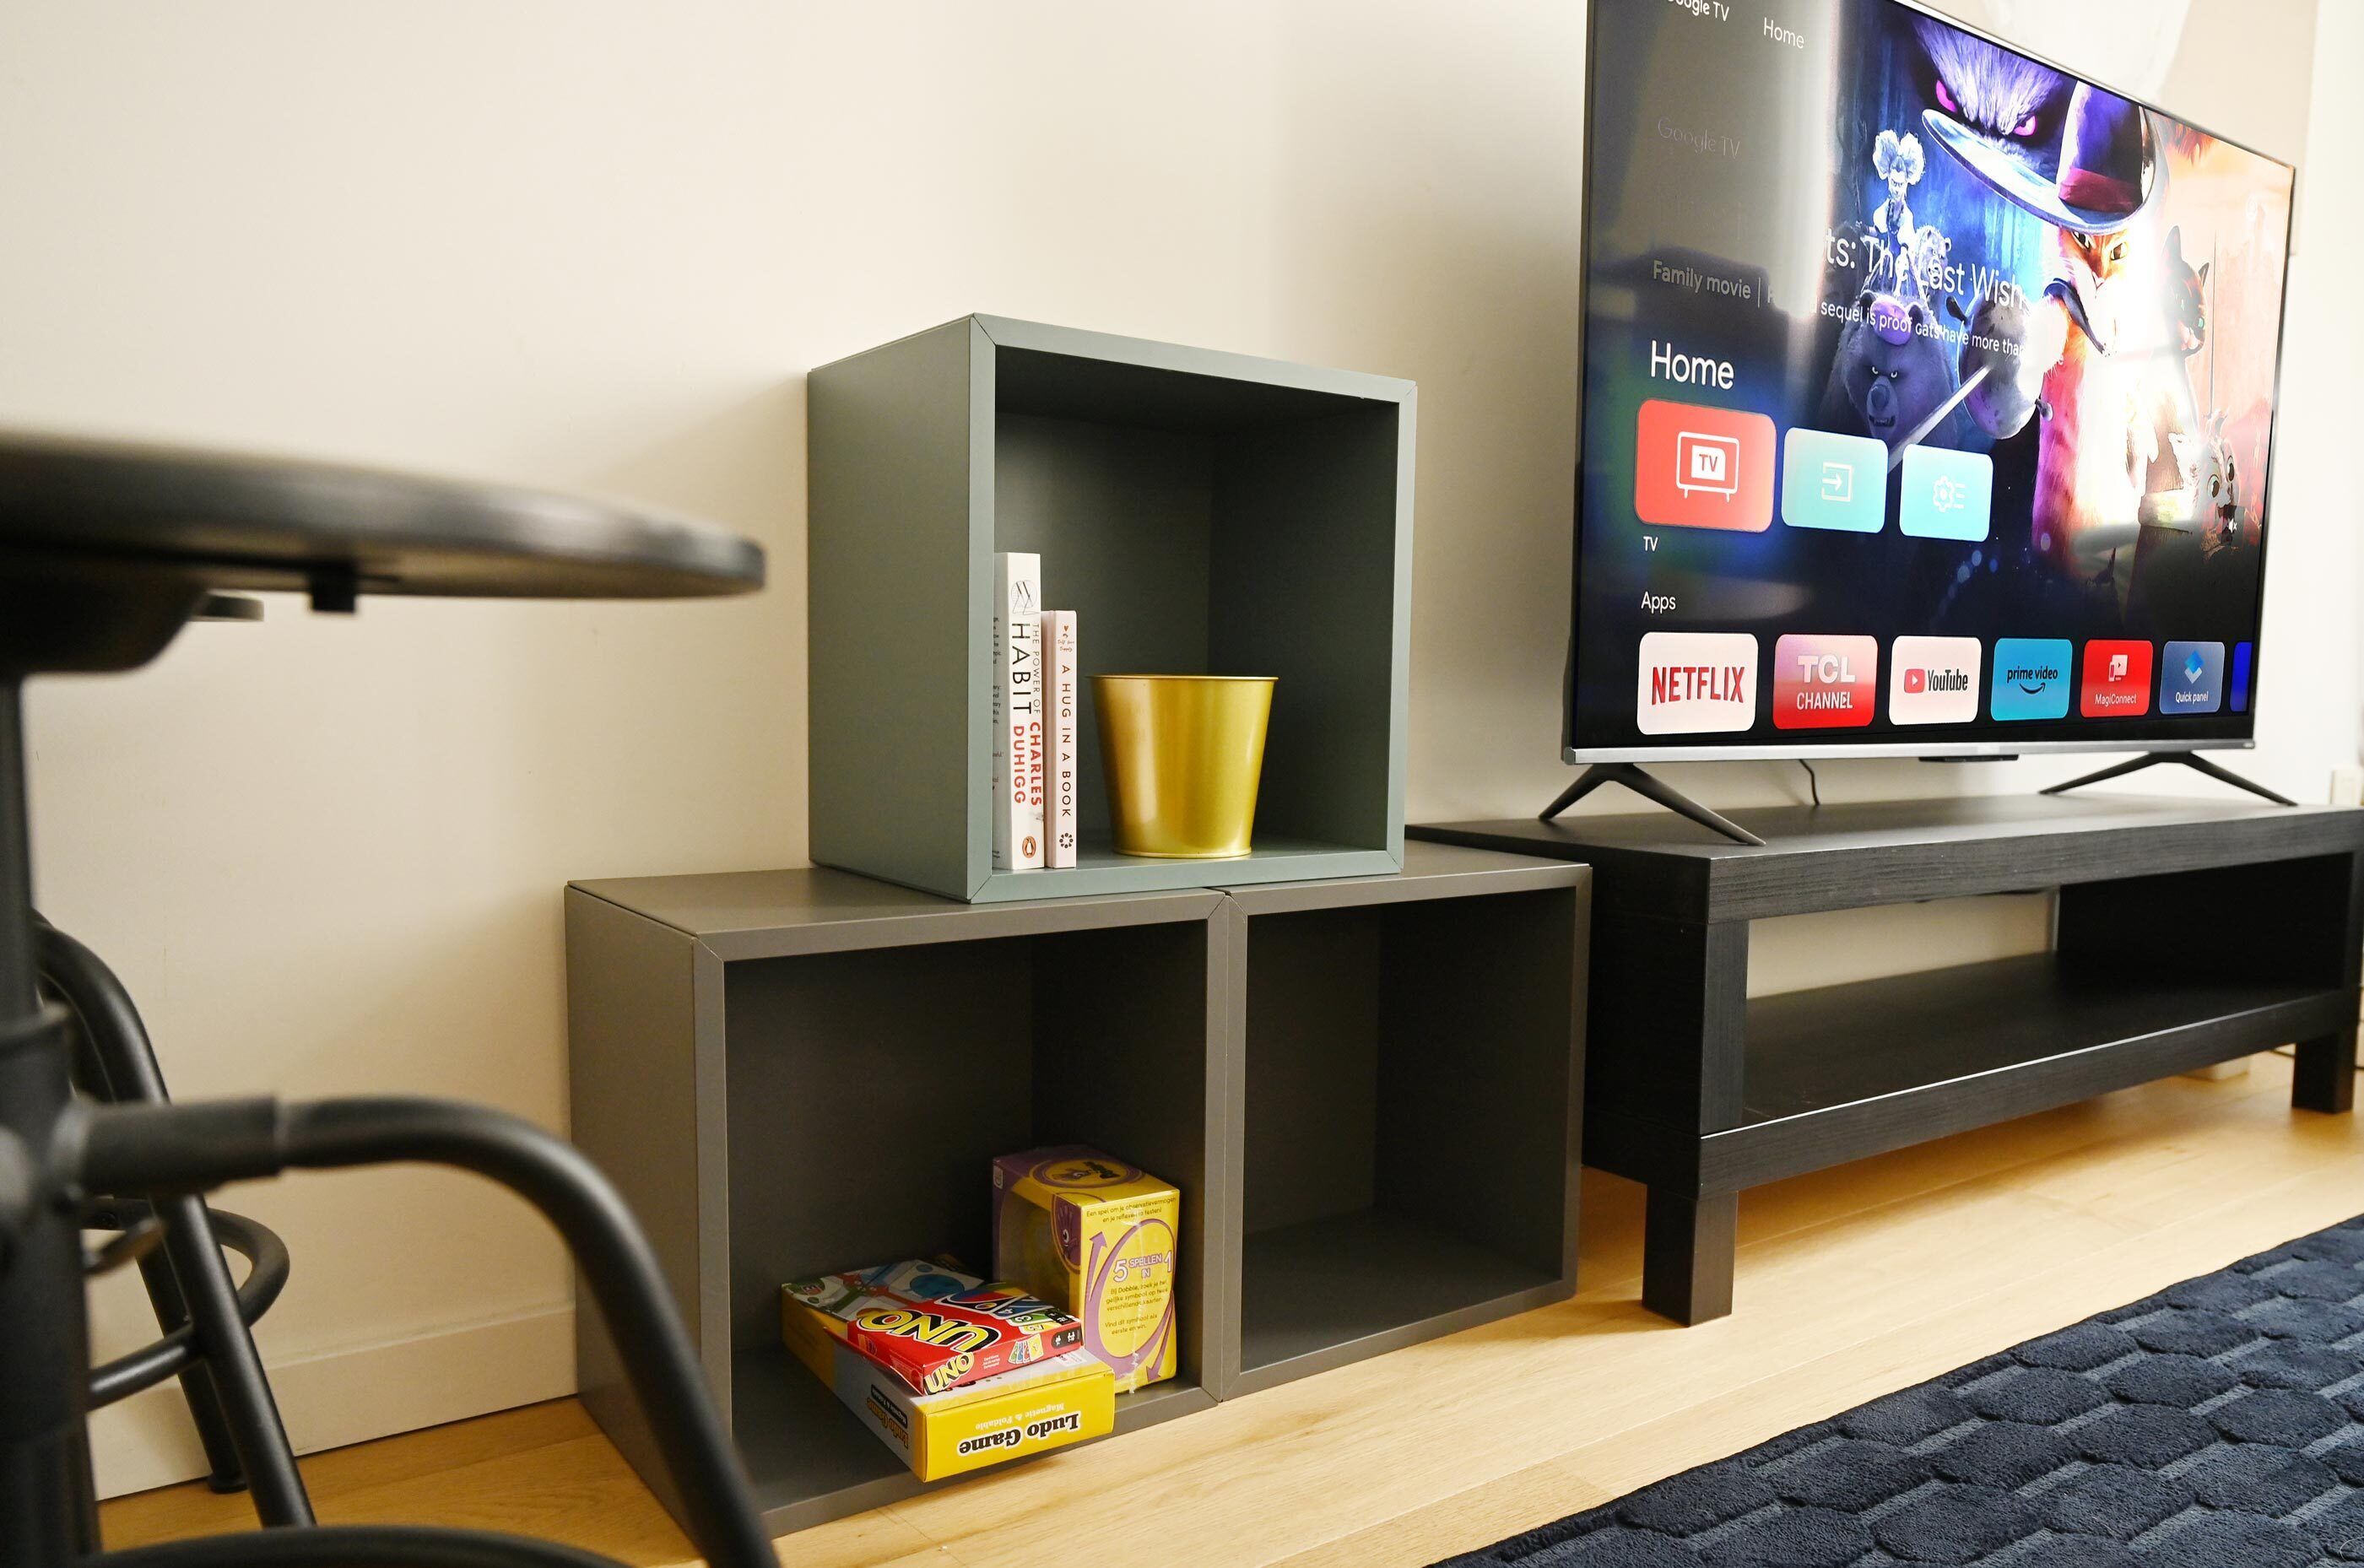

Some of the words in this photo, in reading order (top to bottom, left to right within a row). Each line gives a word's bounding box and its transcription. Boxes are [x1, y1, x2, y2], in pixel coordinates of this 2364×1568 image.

[1712, 2, 1730, 22] TV
[1763, 17, 1804, 49] Home
[1658, 116, 1716, 154] Google
[1722, 135, 1740, 160] TV
[1826, 228, 1856, 269] ts:
[1861, 236, 1909, 282] The
[1653, 260, 1703, 294] Family
[1707, 276, 1751, 300] movie
[1820, 301, 1863, 323] sequel
[1866, 307, 1876, 326] is
[1879, 315, 1913, 333] proof
[1915, 322, 1939, 339] cats
[1941, 324, 1969, 346] have
[1972, 334, 1999, 352] more
[1650, 339, 1735, 390] Home
[1699, 453, 1718, 472] TV
[1642, 535, 1658, 552] TV
[1641, 591, 1676, 614] Apps
[1011, 623, 1032, 714] HABIT
[1032, 651, 1041, 693] POWER
[1062, 665, 1071, 674] A
[1797, 654, 1856, 684] TCL
[1928, 668, 1968, 691] YouTube
[2007, 665, 2033, 683] prime
[2035, 665, 2058, 679] video
[1062, 684, 1072, 718] HUG
[1651, 666, 1745, 706] NETFLIX
[1796, 691, 1854, 710] CHANNEL
[2175, 691, 2192, 703] Quick
[2193, 691, 2209, 704] panel
[1033, 698, 1041, 714] OF
[1062, 727, 1071, 743] IN
[1014, 726, 1026, 804] DUHIGG
[1030, 722, 1042, 806] CHARLES
[1062, 753, 1071, 761] A
[1062, 771, 1072, 817] BOOK
[1112, 1258, 1128, 1283] 5
[1128, 1253, 1163, 1268] SPELLEN
[1164, 1250, 1172, 1273] 1
[857, 1309, 1002, 1354] UNO
[924, 1352, 975, 1395] UNO
[975, 1415, 1014, 1431] Foldable
[1025, 1403, 1065, 1419] Magnetic
[1026, 1413, 1079, 1438] Ludo
[959, 1428, 1021, 1454] Game
